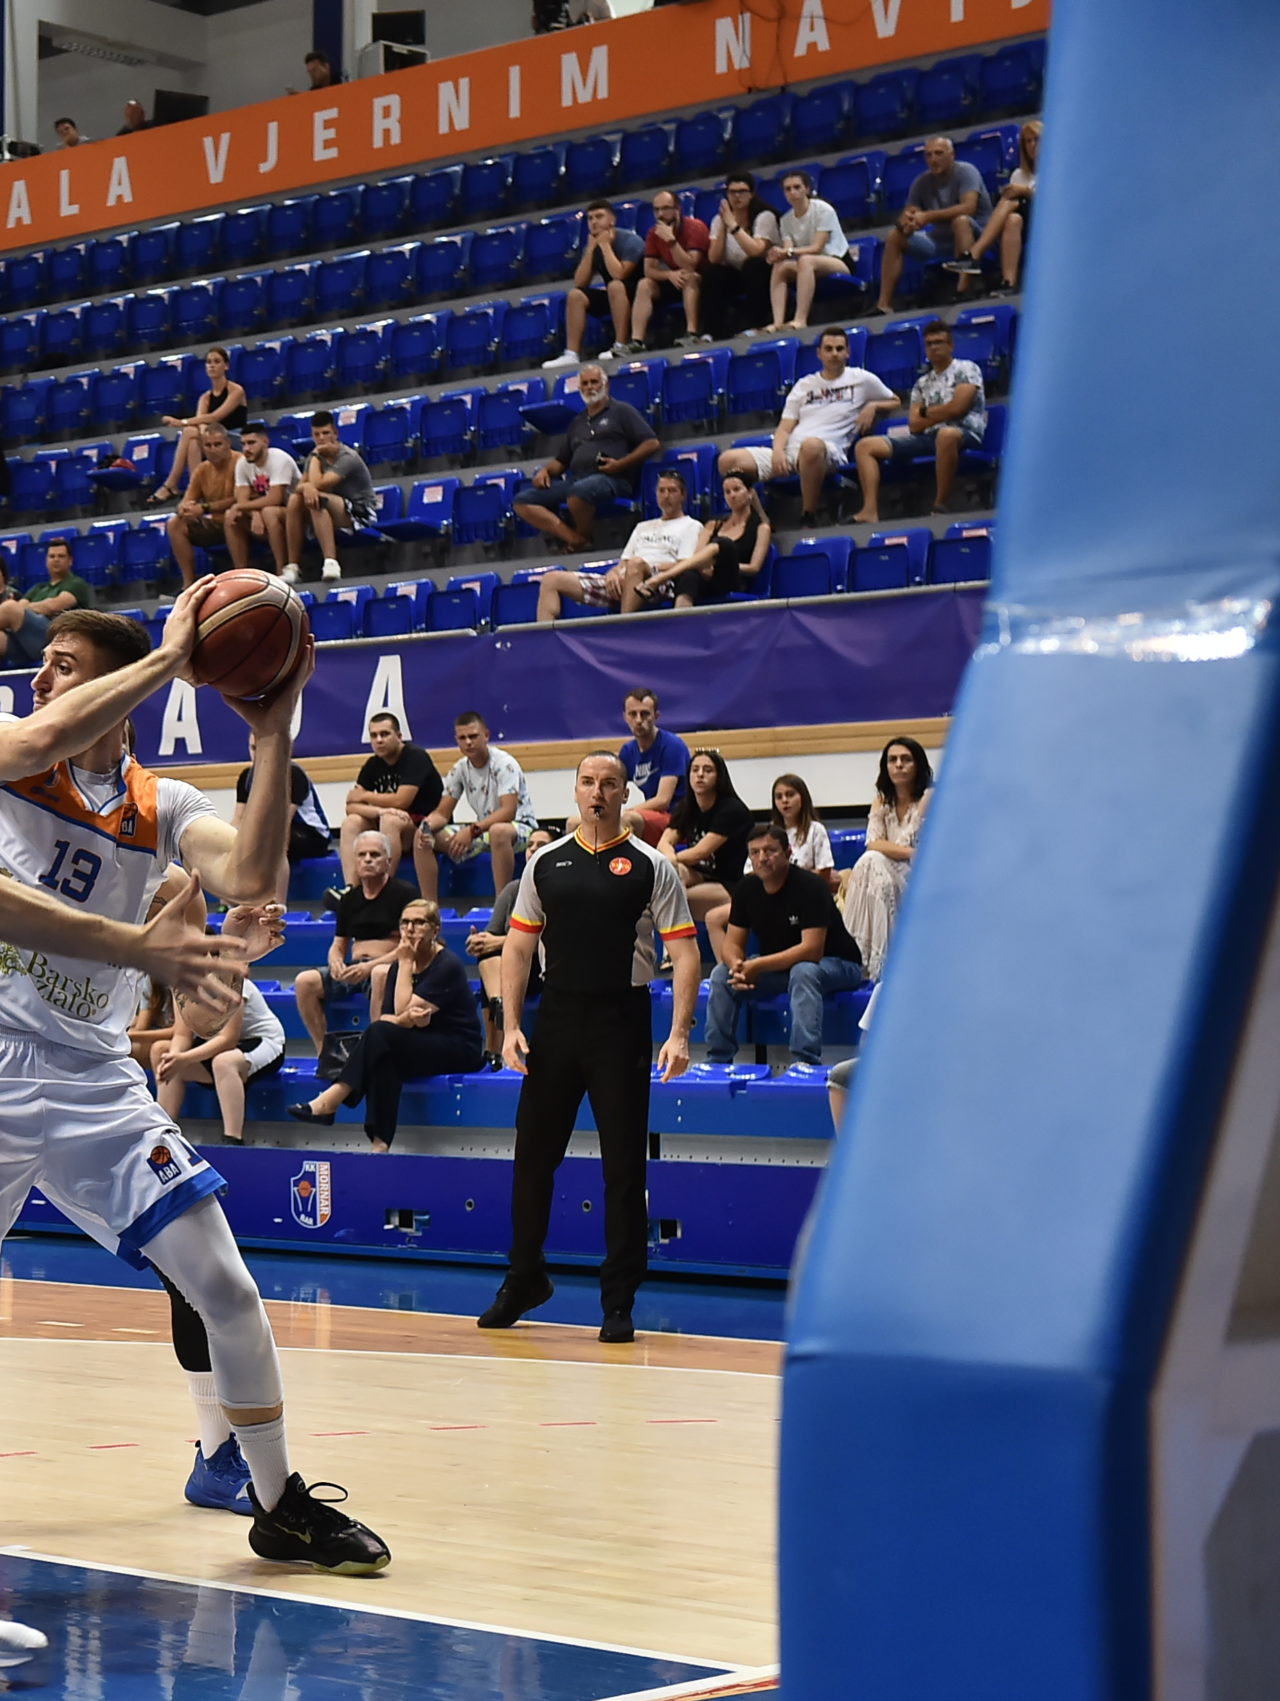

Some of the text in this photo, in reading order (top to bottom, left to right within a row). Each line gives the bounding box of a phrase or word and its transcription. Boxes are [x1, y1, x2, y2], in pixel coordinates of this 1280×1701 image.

[203, 44, 609, 184] VJERNIM
[715, 0, 1033, 74] NAV
[38, 840, 103, 903] 13
[27, 952, 109, 1009] Barsko
[158, 1163, 180, 1183] ABA
[319, 1163, 329, 1214] MORNAR
